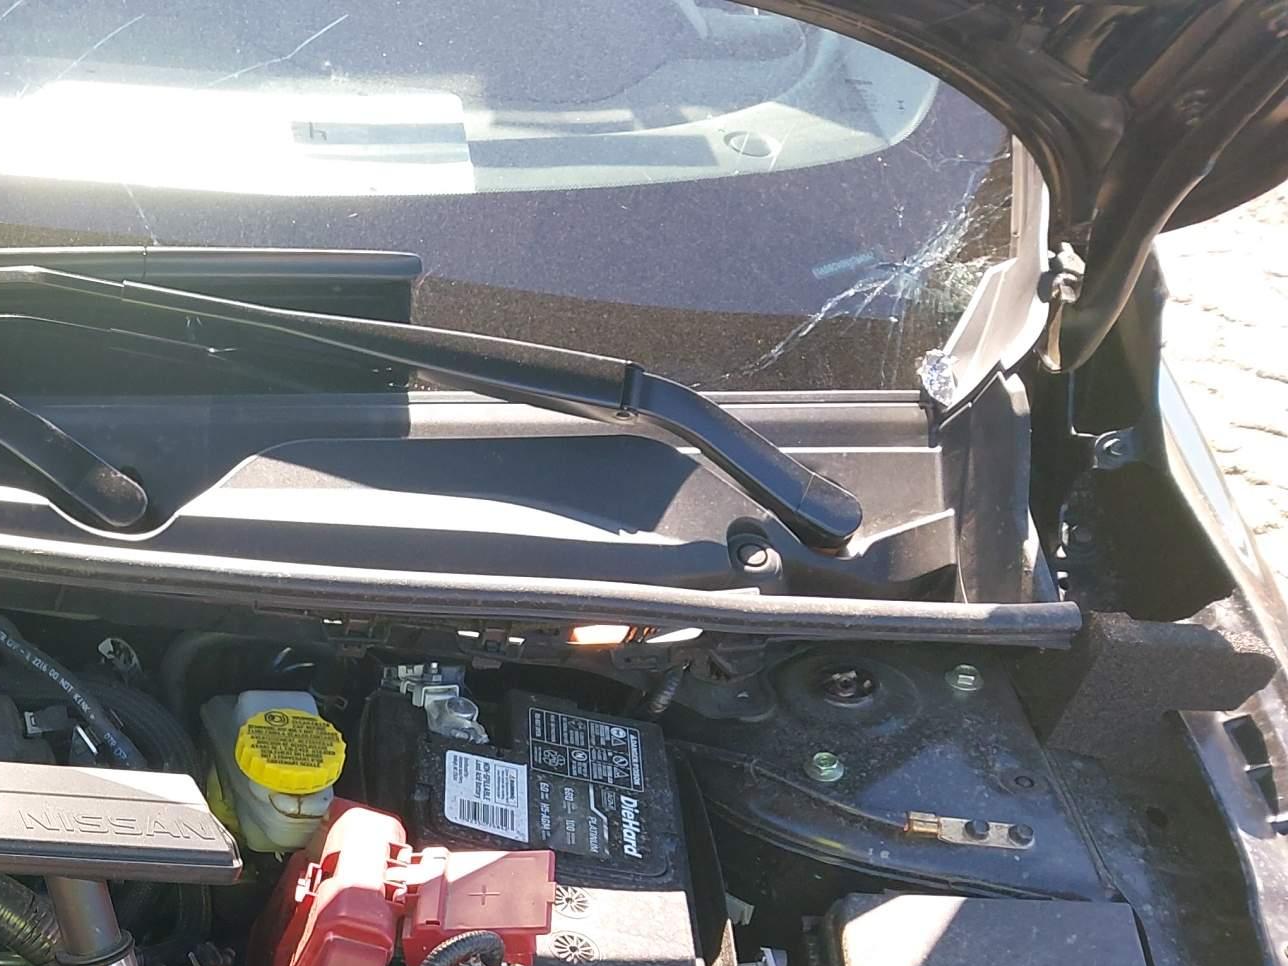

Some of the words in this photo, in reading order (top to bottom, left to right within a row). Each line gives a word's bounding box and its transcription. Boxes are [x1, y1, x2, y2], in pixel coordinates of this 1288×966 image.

[48, 668, 60, 680] DO
[59, 678, 74, 693] NOT
[73, 693, 91, 712] KINK
[18, 808, 216, 841] NISSAN
[588, 815, 599, 854] PLATINUM
[620, 794, 643, 859] DieHard
